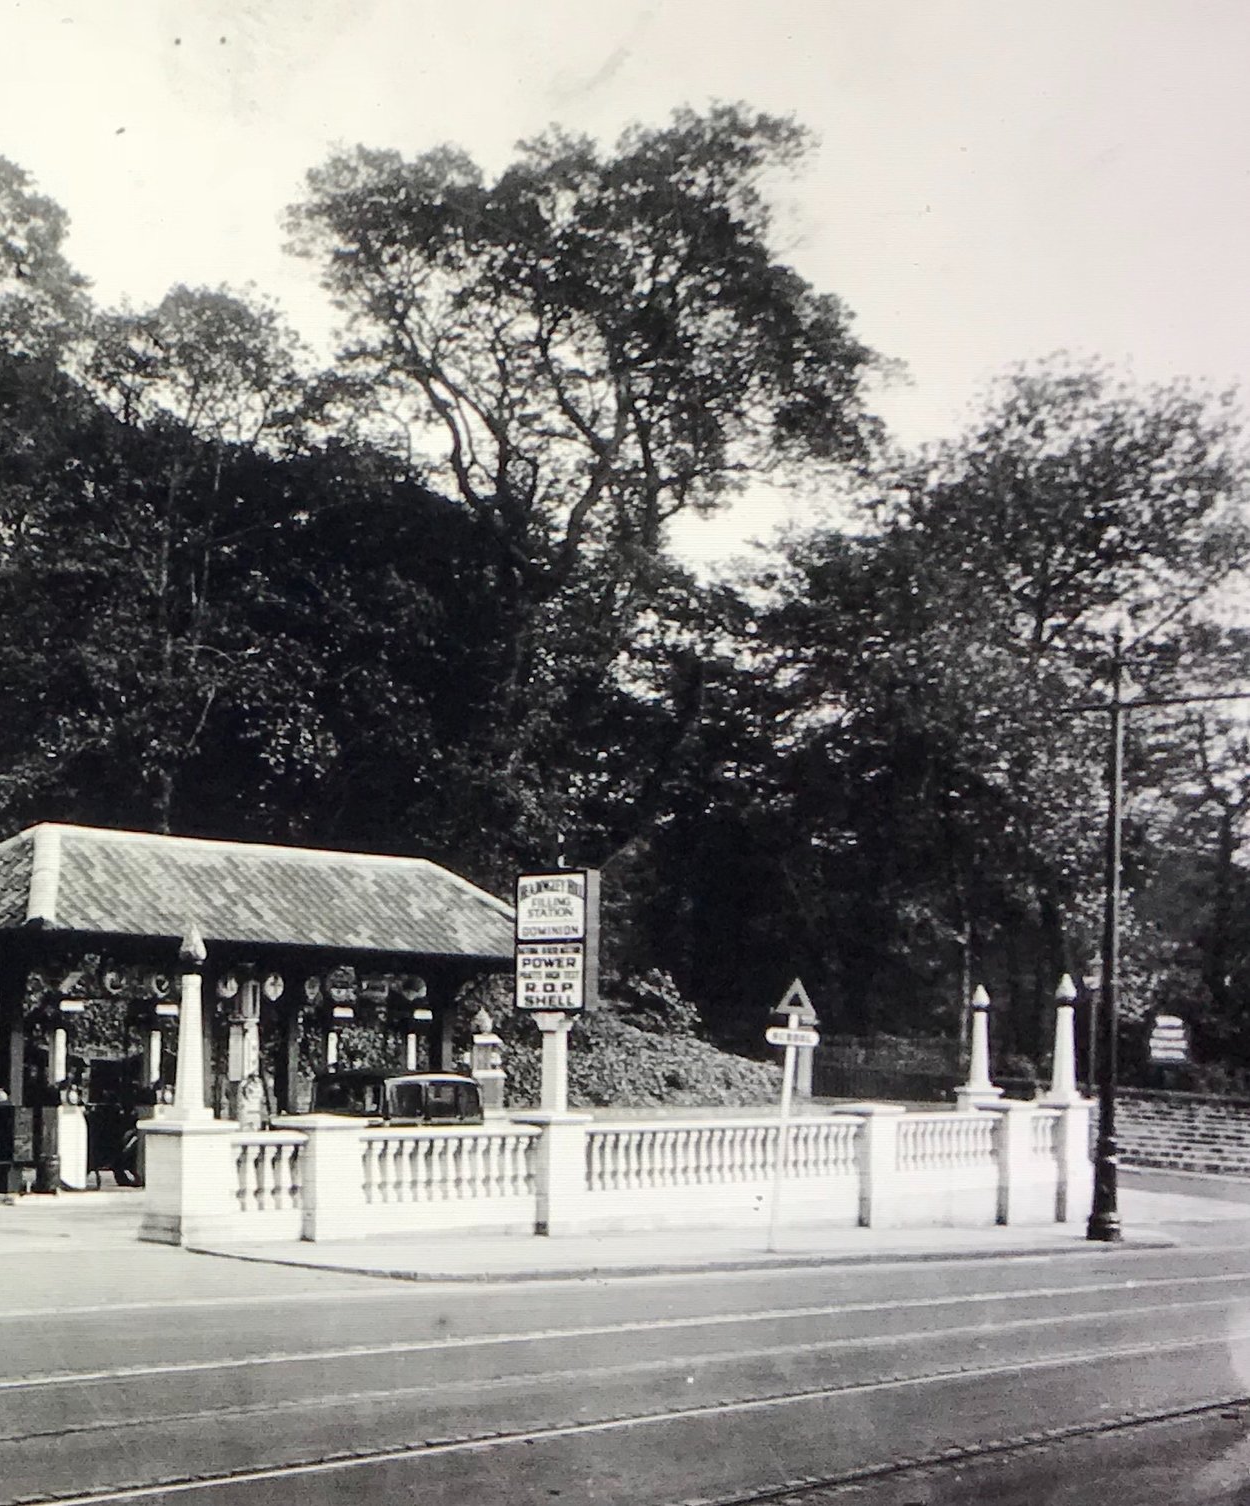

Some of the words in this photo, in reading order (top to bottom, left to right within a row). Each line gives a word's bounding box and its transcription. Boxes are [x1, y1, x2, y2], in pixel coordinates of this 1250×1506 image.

[531, 897, 571, 907] FILLING
[528, 907, 574, 918] STATION
[522, 926, 579, 937] DOMINION
[522, 957, 576, 968] POWER
[524, 995, 575, 1007] SHELL
